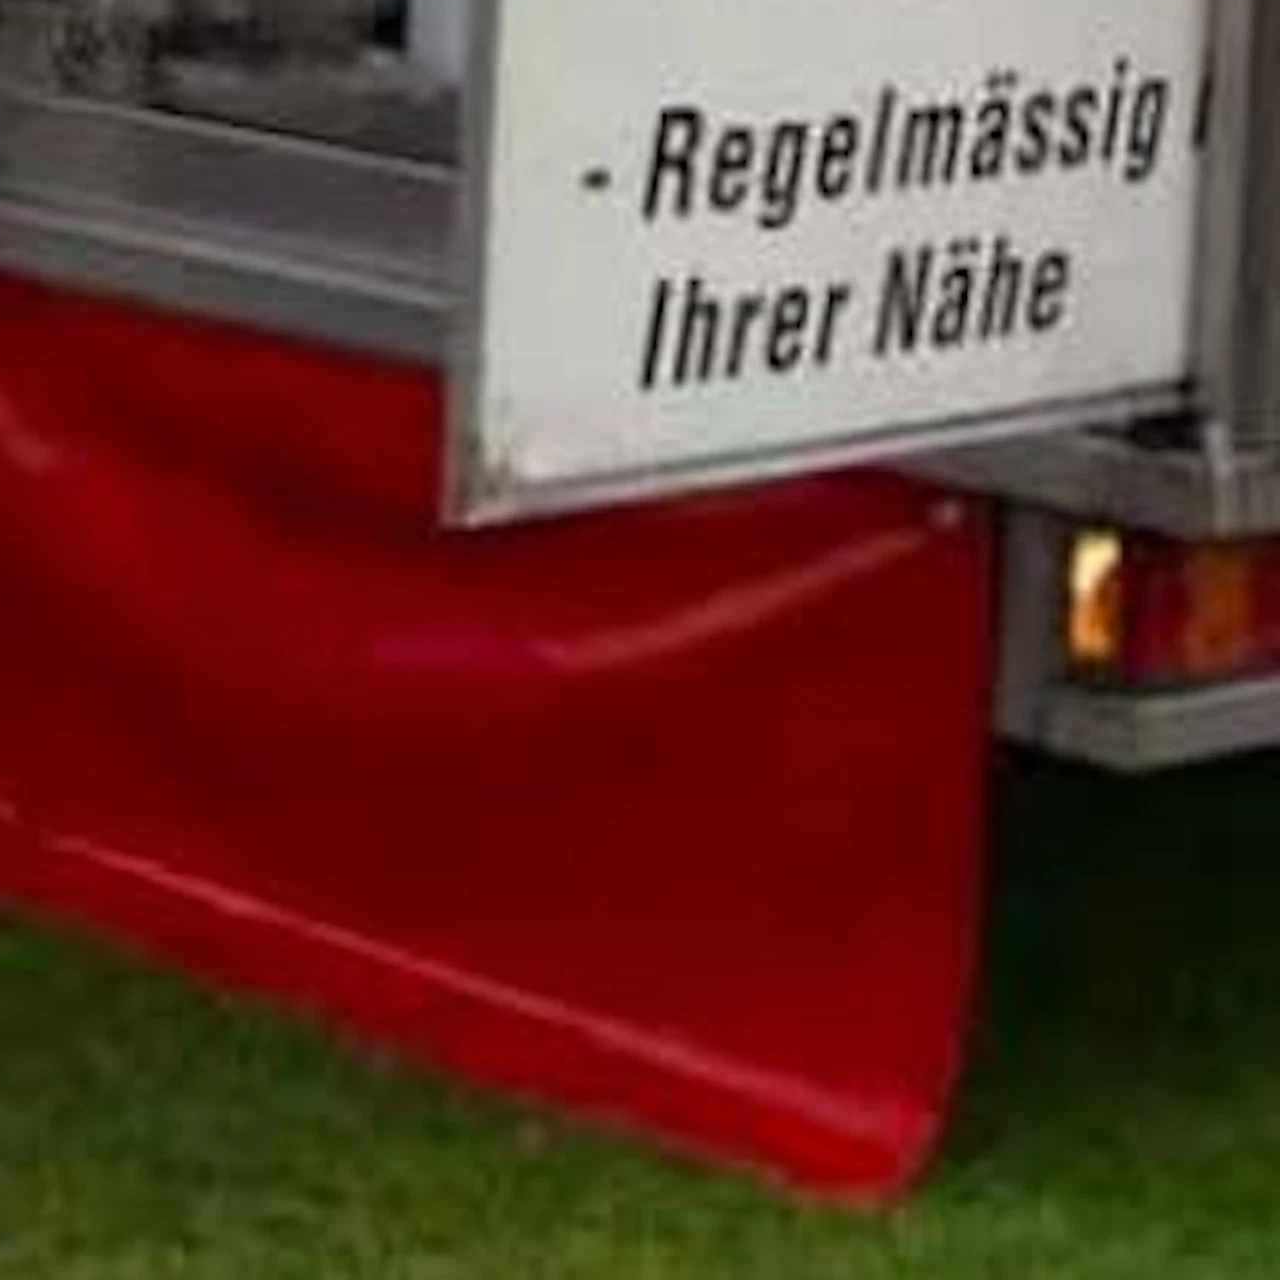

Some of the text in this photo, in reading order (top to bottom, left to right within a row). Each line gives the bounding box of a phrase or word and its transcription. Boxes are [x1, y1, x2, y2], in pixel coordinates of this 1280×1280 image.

[641, 56, 1171, 232] Regelmässig
[638, 235, 1071, 392] Ihrer Nähe
